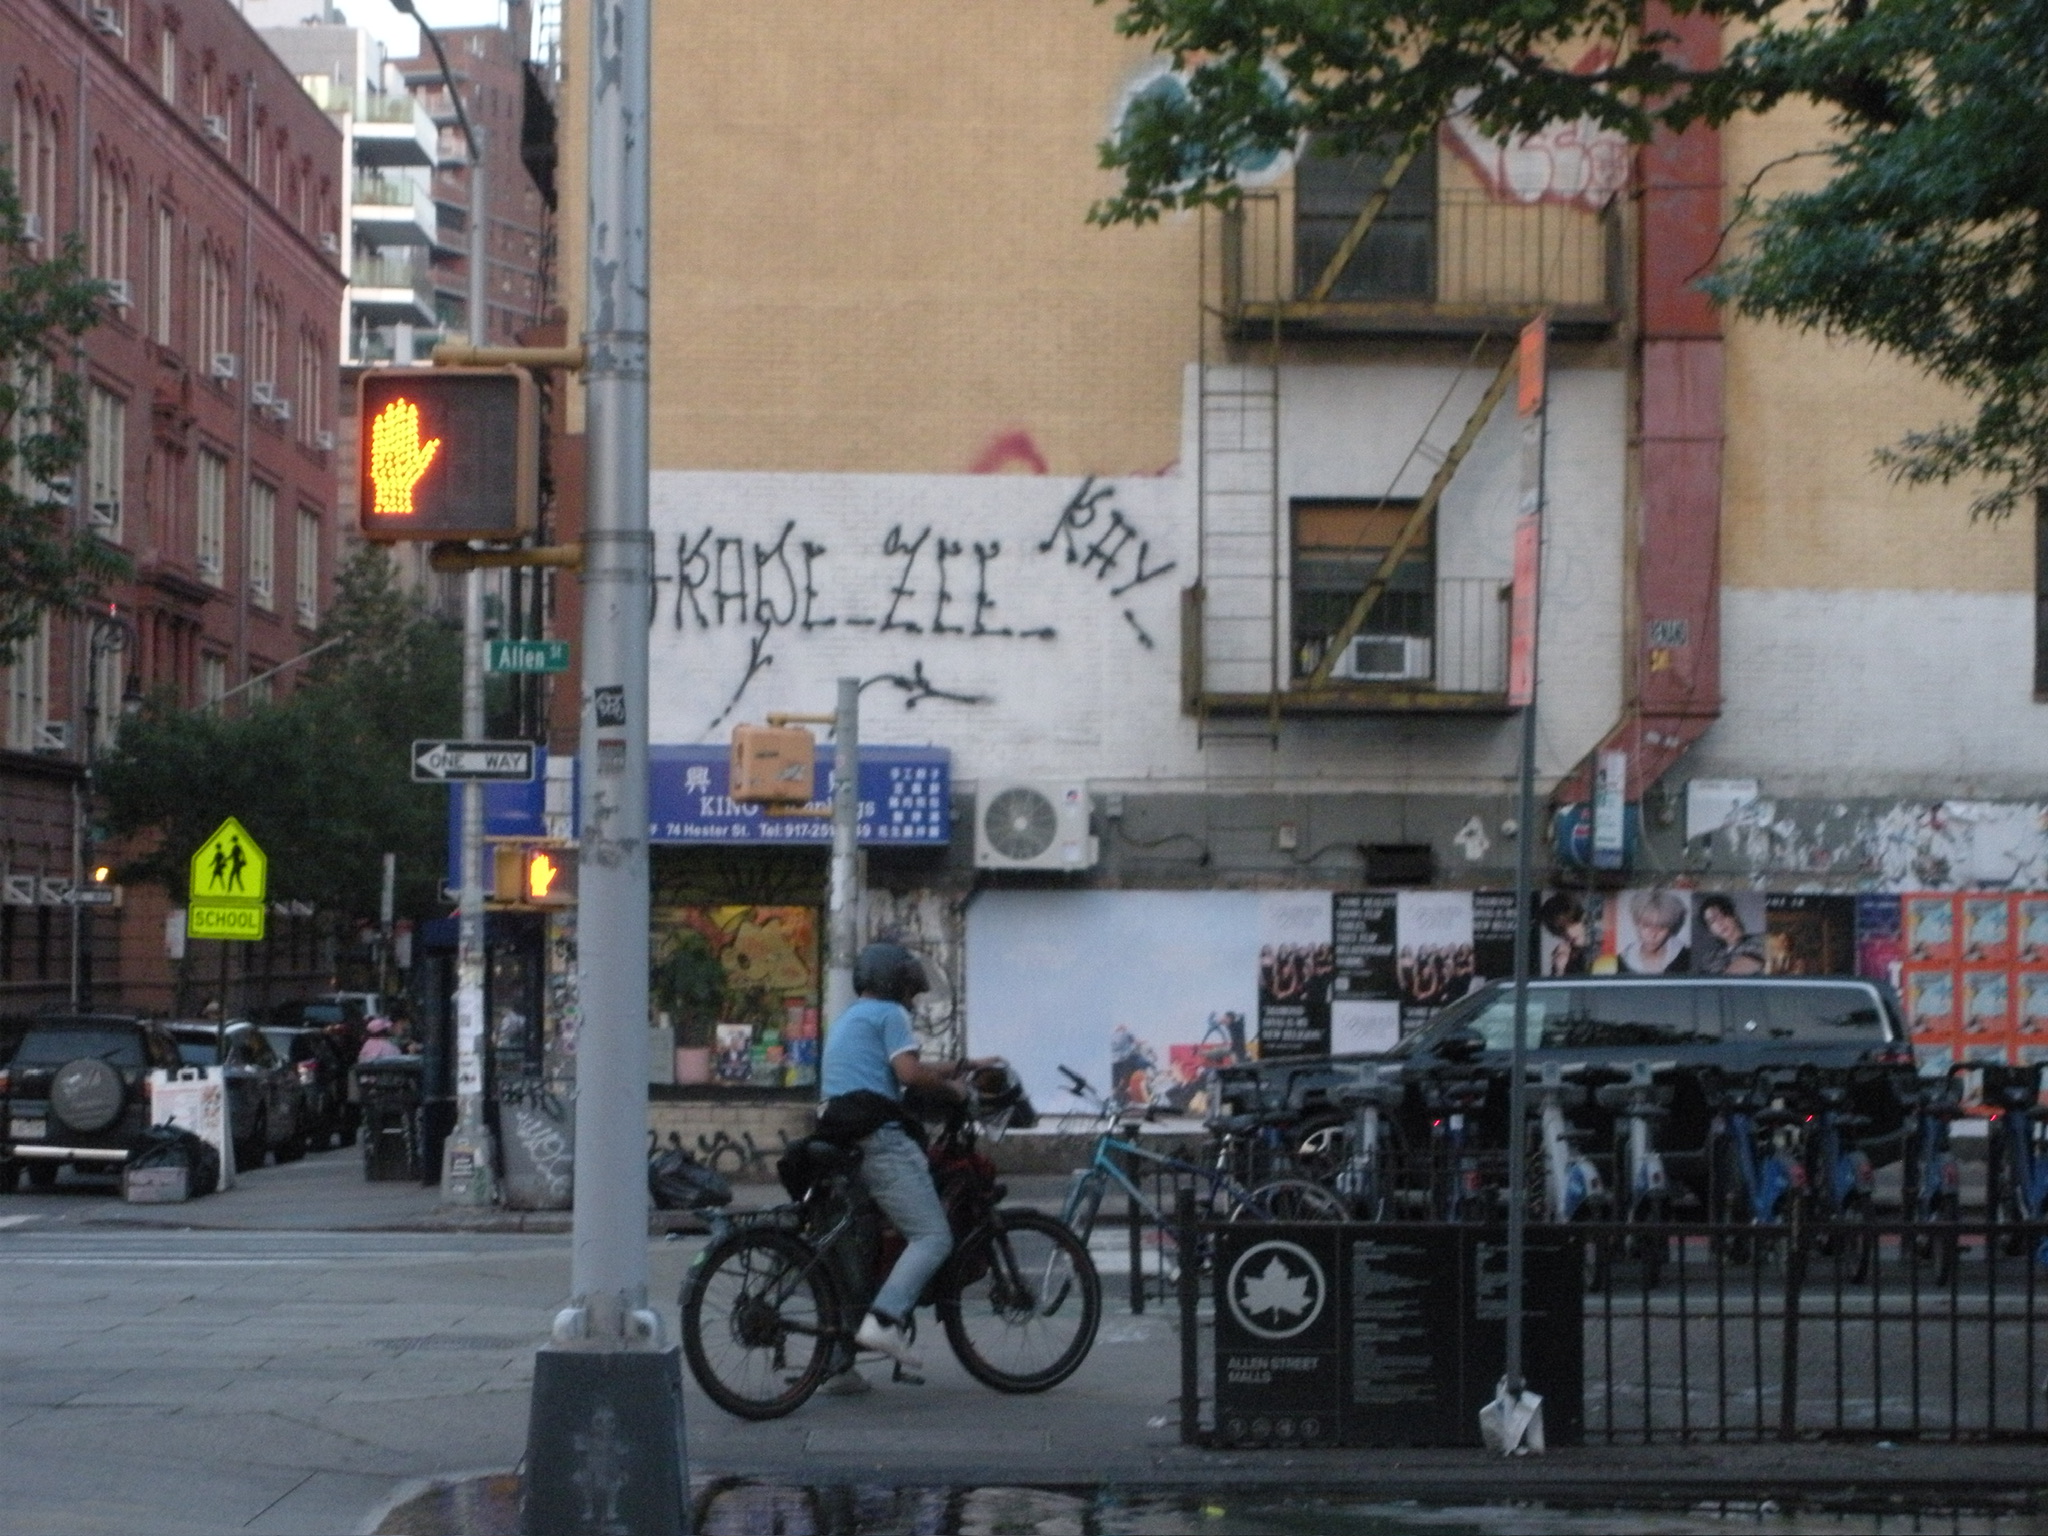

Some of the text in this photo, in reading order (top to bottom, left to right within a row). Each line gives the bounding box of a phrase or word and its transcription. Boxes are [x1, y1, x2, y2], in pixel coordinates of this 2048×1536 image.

[499, 645, 545, 669] Allen
[429, 753, 522, 769] ONE WAY
[684, 823, 729, 837] Hester
[195, 911, 258, 929] SCHOOL
